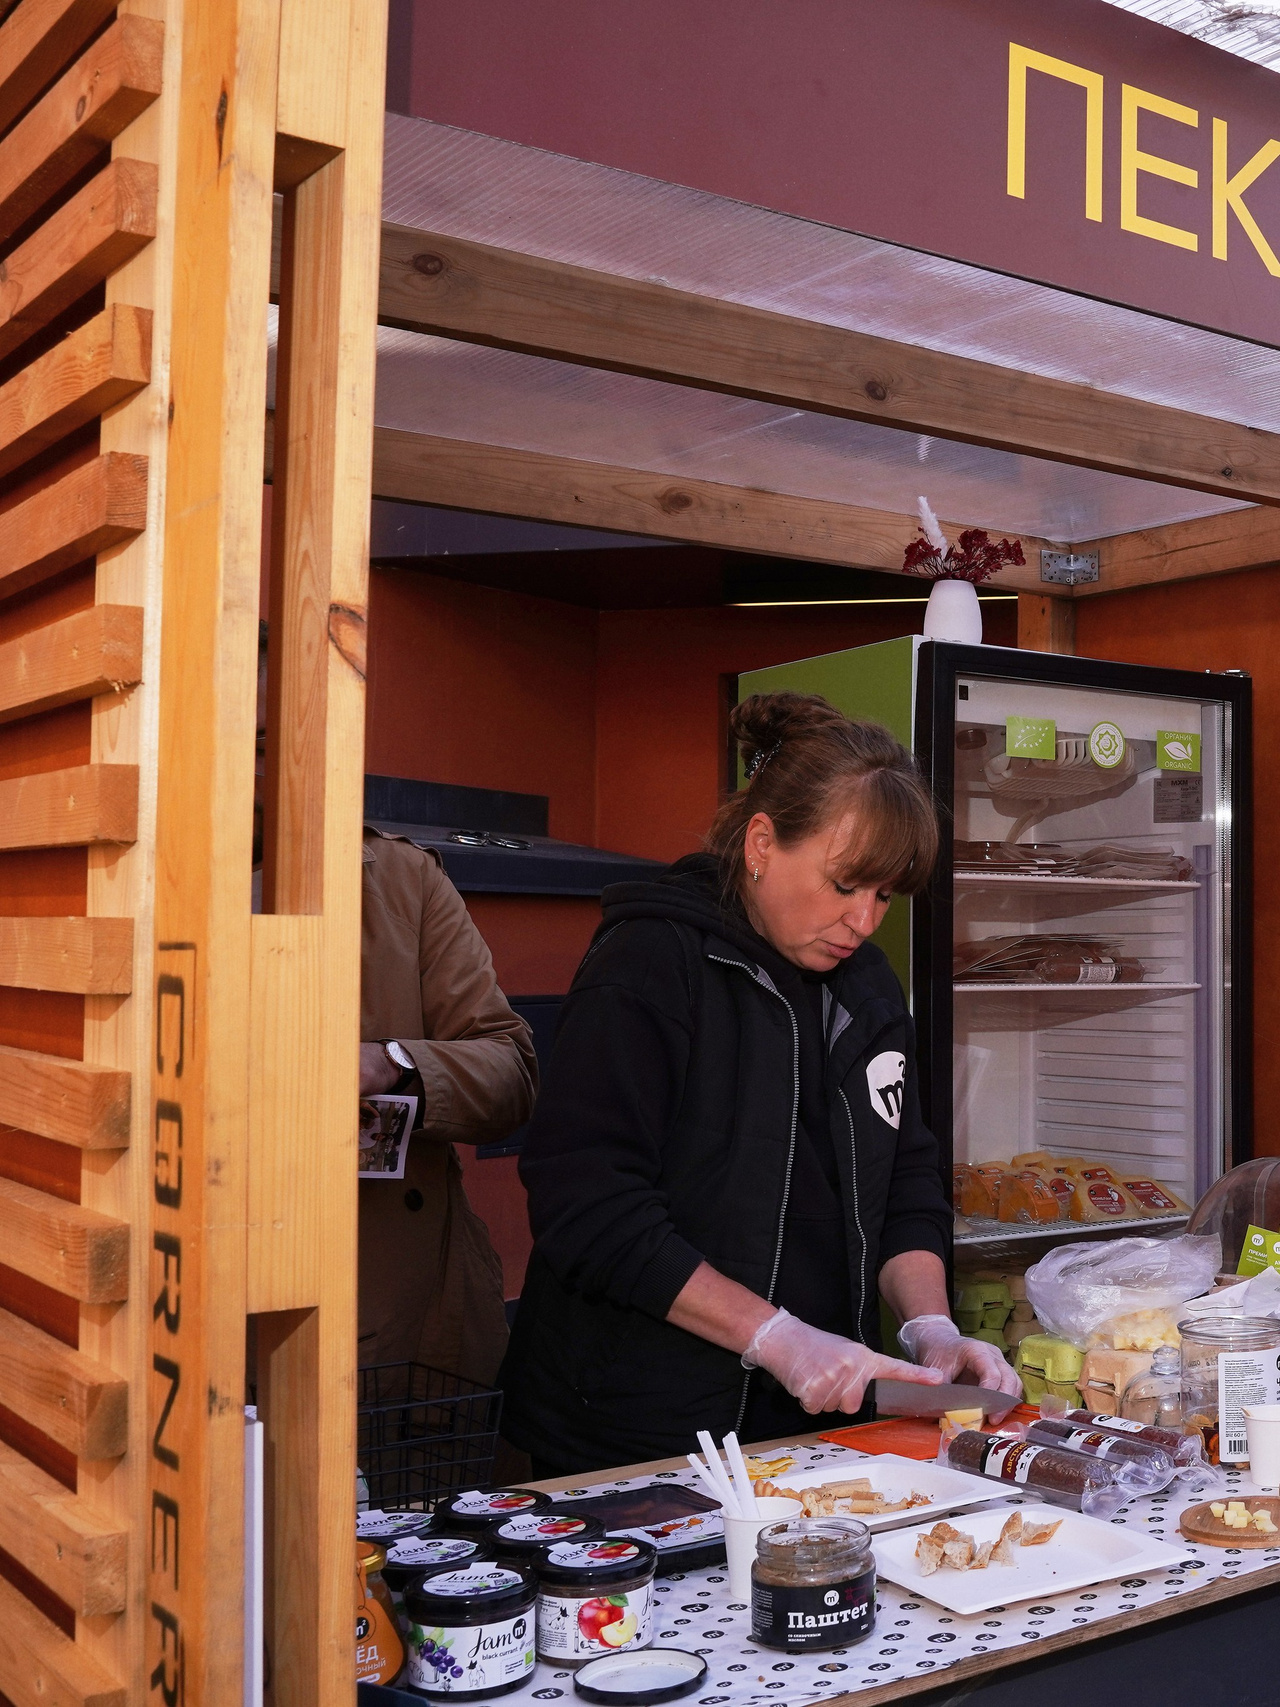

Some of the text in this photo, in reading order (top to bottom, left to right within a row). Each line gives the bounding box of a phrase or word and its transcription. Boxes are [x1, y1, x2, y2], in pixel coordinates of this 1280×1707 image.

[1165, 733, 1192, 741] ОРГАНИК
[1165, 761, 1192, 769] ORGANIC
[148, 972, 185, 1707] CORNER
[787, 1602, 868, 1629] Паштет
[468, 1627, 512, 1658] Jam
[356, 1645, 379, 1664] ЁД
[482, 1646, 518, 1661] black currant
[356, 1657, 386, 1675] очный
